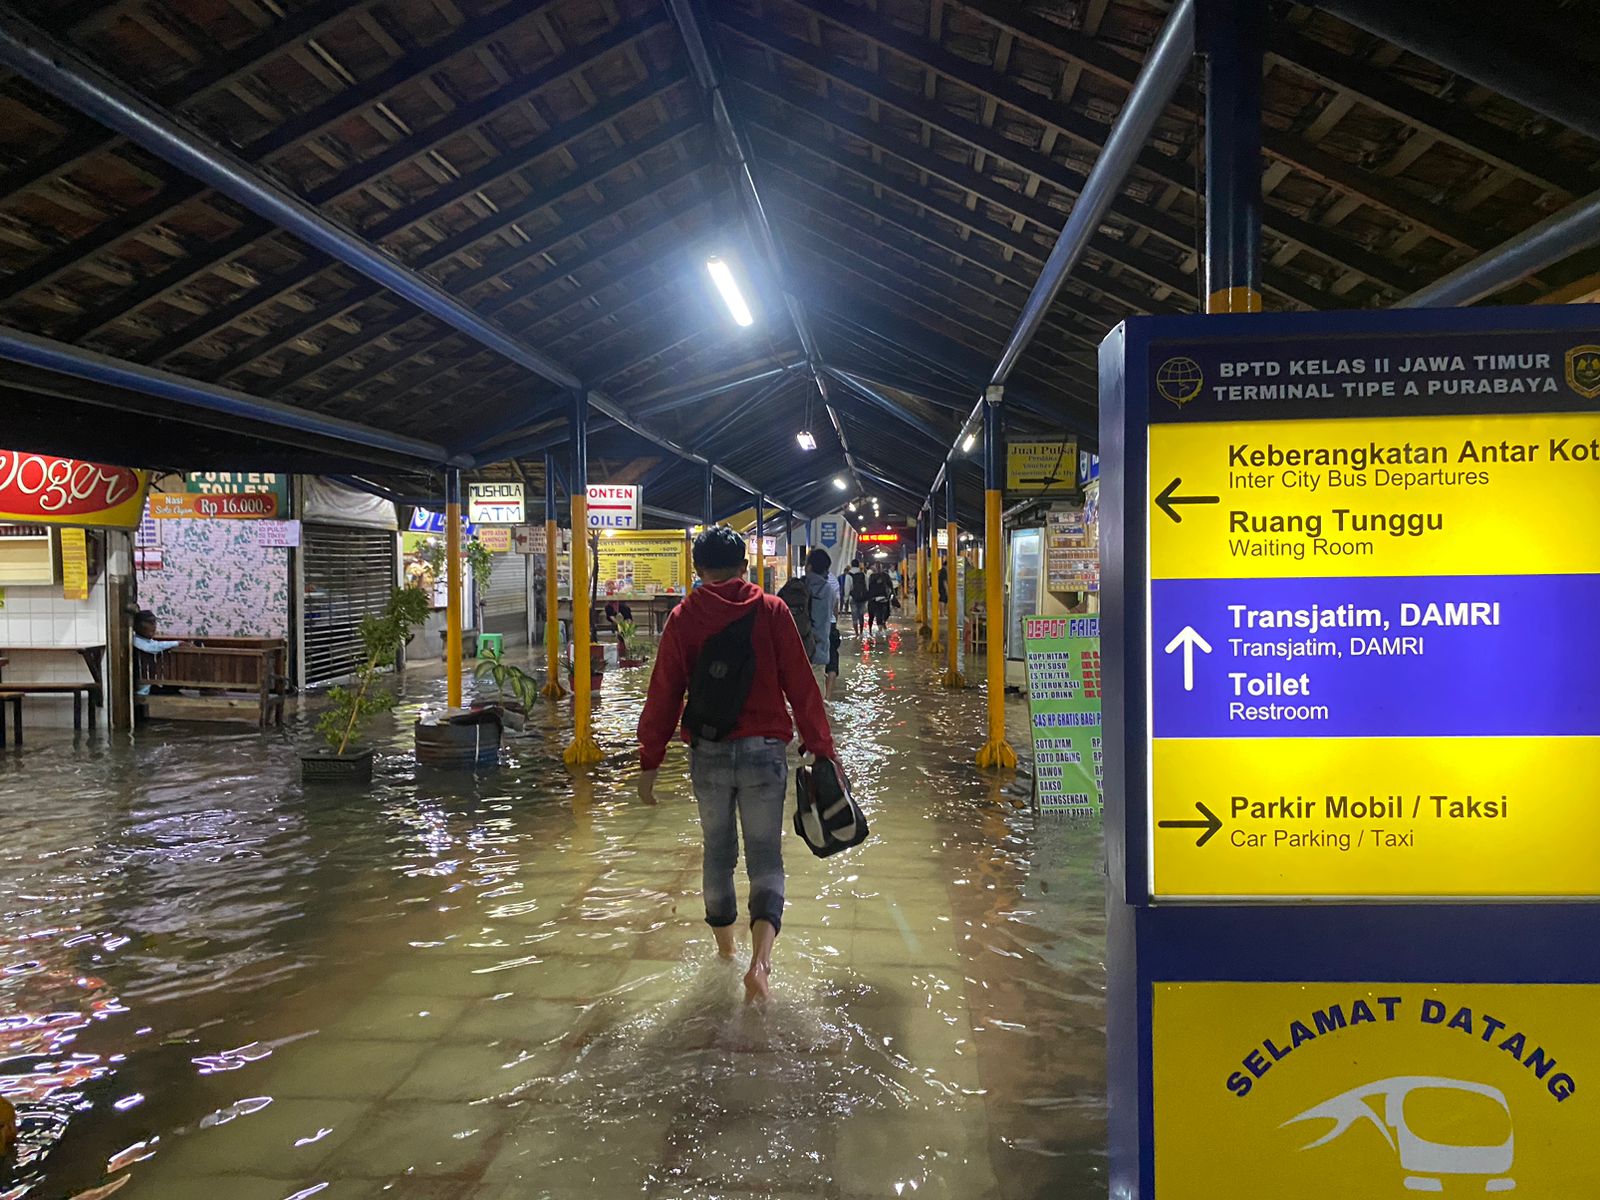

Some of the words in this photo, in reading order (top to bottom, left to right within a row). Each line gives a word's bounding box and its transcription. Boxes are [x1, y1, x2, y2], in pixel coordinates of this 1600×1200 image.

[1220, 362, 1280, 378] BPTD
[1289, 359, 1366, 376] KELAS
[1374, 358, 1390, 373] II
[1398, 355, 1465, 373] JAWA
[1473, 354, 1551, 371] TIMUR
[1213, 382, 1334, 401] TERMINAL
[1342, 380, 1396, 398] TIPE
[1403, 380, 1420, 395] A
[1428, 377, 1558, 395] PURABAYA
[1011, 446, 1037, 455] Jual
[1041, 446, 1074, 455] Pulsa
[1228, 442, 1447, 470] Keberangkatan
[1457, 439, 1539, 464] Antar
[1228, 471, 1275, 489] Inter
[1281, 470, 1321, 493] City
[1328, 470, 1367, 488] Bus
[1375, 468, 1490, 492] Departures
[469, 484, 522, 498] MUSHOLA
[165, 496, 183, 505] Nasi
[200, 499, 218, 517] Rp
[478, 507, 521, 521] ATM
[587, 515, 633, 526] OILET
[1229, 511, 1322, 538] Ruang
[1332, 509, 1443, 536] Tunggu
[1229, 539, 1306, 561] Waiting
[1313, 538, 1374, 556] Room
[1228, 604, 1390, 634] Transjatim,
[1400, 602, 1501, 628] DAMRI
[1026, 619, 1066, 638] DEPOT
[1028, 653, 1046, 661] KOPI
[1046, 652, 1069, 660] HITAM
[1228, 638, 1343, 661] Transjatim,
[1350, 637, 1424, 656] DAMRI
[1047, 662, 1067, 670] SUSU
[1030, 672, 1038, 680] ES
[1228, 672, 1310, 697] Toilet
[1050, 691, 1073, 699] DRINK
[1033, 714, 1047, 727] CAS
[1047, 713, 1056, 726] HP
[1057, 712, 1080, 726] GRATIS
[1080, 712, 1096, 726] BAGI
[1229, 702, 1329, 721] Restroom
[1035, 739, 1053, 749] SOTO
[1054, 738, 1072, 749] AYAM
[1036, 752, 1054, 763] SOTO
[1055, 752, 1081, 763] DAGING
[1038, 766, 1063, 777] RAWON
[1039, 781, 1062, 791] BAKSO
[1041, 793, 1089, 805] KRENGSENGAN
[1230, 796, 1316, 819] Parkir
[1325, 795, 1403, 818] Mobil
[1410, 796, 1422, 819] /
[1429, 795, 1508, 818] Taksi
[1230, 829, 1266, 848] Car
[1274, 829, 1351, 851] Parking
[1356, 829, 1365, 848] /
[1371, 829, 1414, 848] Taxi
[1226, 997, 1402, 1097] SELAMAT
[1420, 998, 1576, 1102] DATANG
